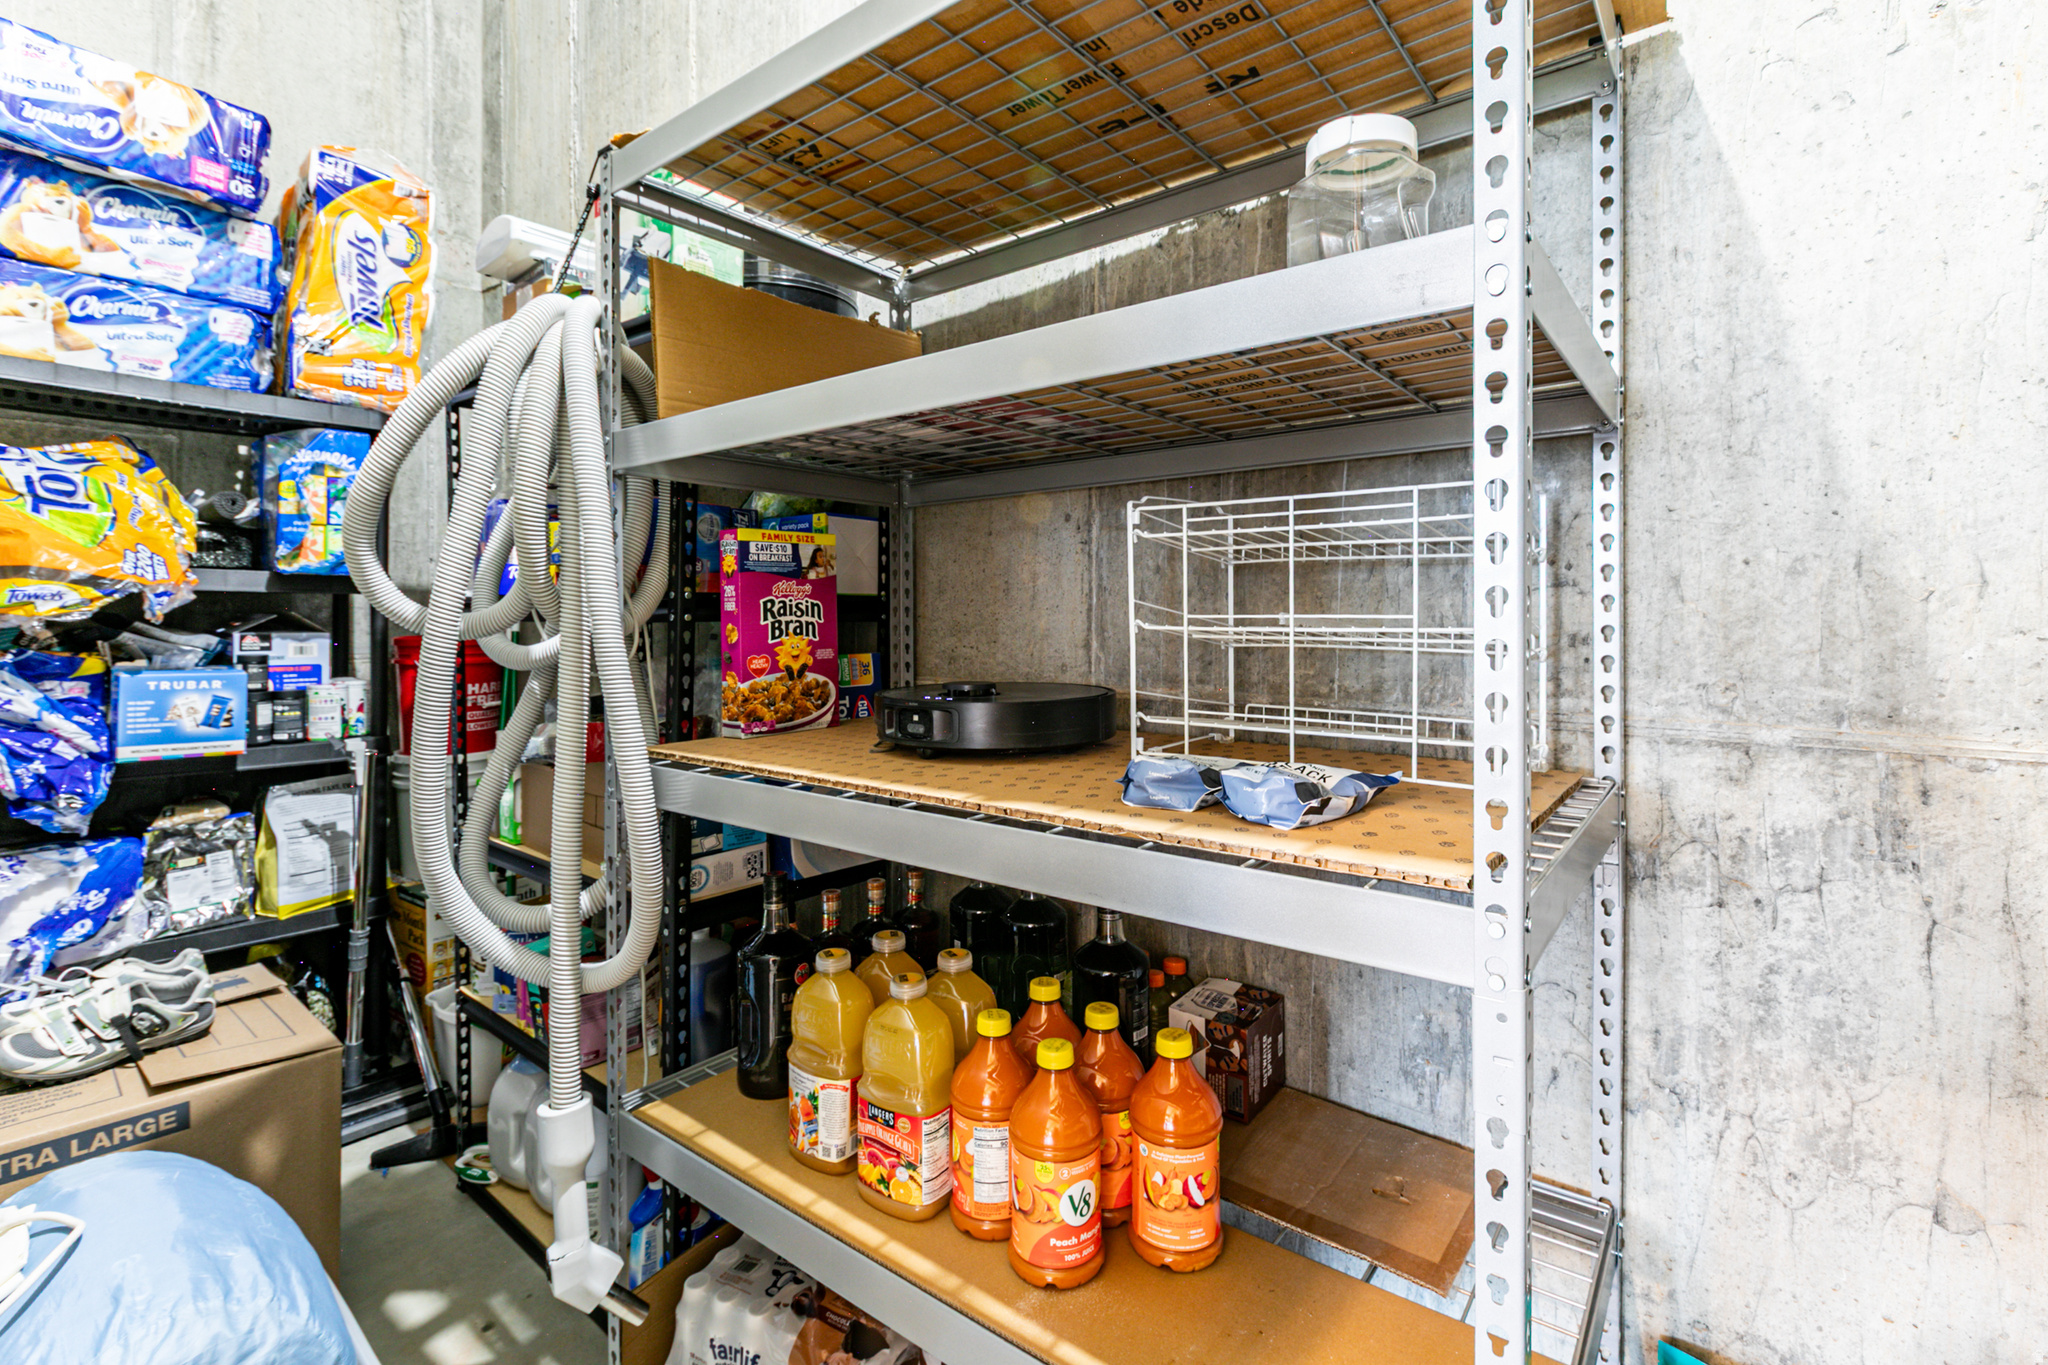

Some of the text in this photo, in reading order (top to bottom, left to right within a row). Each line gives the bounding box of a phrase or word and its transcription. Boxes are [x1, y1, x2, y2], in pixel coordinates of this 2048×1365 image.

[1008, 63, 1126, 117] Power Tower
[20, 100, 119, 140] Charmin
[759, 132, 791, 150] LIFT
[229, 180, 256, 199] 30
[94, 197, 180, 226] Charmin
[130, 235, 194, 249] Ulta Soft
[406, 237, 415, 254] 150
[350, 230, 384, 330] Towels
[71, 296, 158, 319] Charmin
[146, 331, 175, 343] Soft
[797, 522, 809, 530] pack
[761, 532, 815, 544] FAMILY SIZE
[755, 544, 774, 553] SAVE
[136, 543, 154, 581] 2200
[759, 554, 793, 563] BREAKFAST
[7, 589, 67, 605] Towels
[772, 580, 812, 598] Kellogg's
[761, 597, 823, 623] Raisin
[769, 618, 818, 642] Bran
[861, 661, 870, 676] 36
[146, 680, 222, 691] TRUBAR
[1149, 771, 1172, 779] Legendary
[868, 1104, 894, 1126] LANGERS
[69, 1110, 178, 1158] LARGE
[895, 1134, 912, 1154] GUAVA
[1001, 1140, 1008, 1148] 90
[1151, 1153, 1162, 1161] Blend
[1156, 1151, 1174, 1159] Delicious
[1068, 1186, 1092, 1218] V8
[1050, 1236, 1078, 1247] Peach
[1065, 1244, 1095, 1262] 100% JUICE
